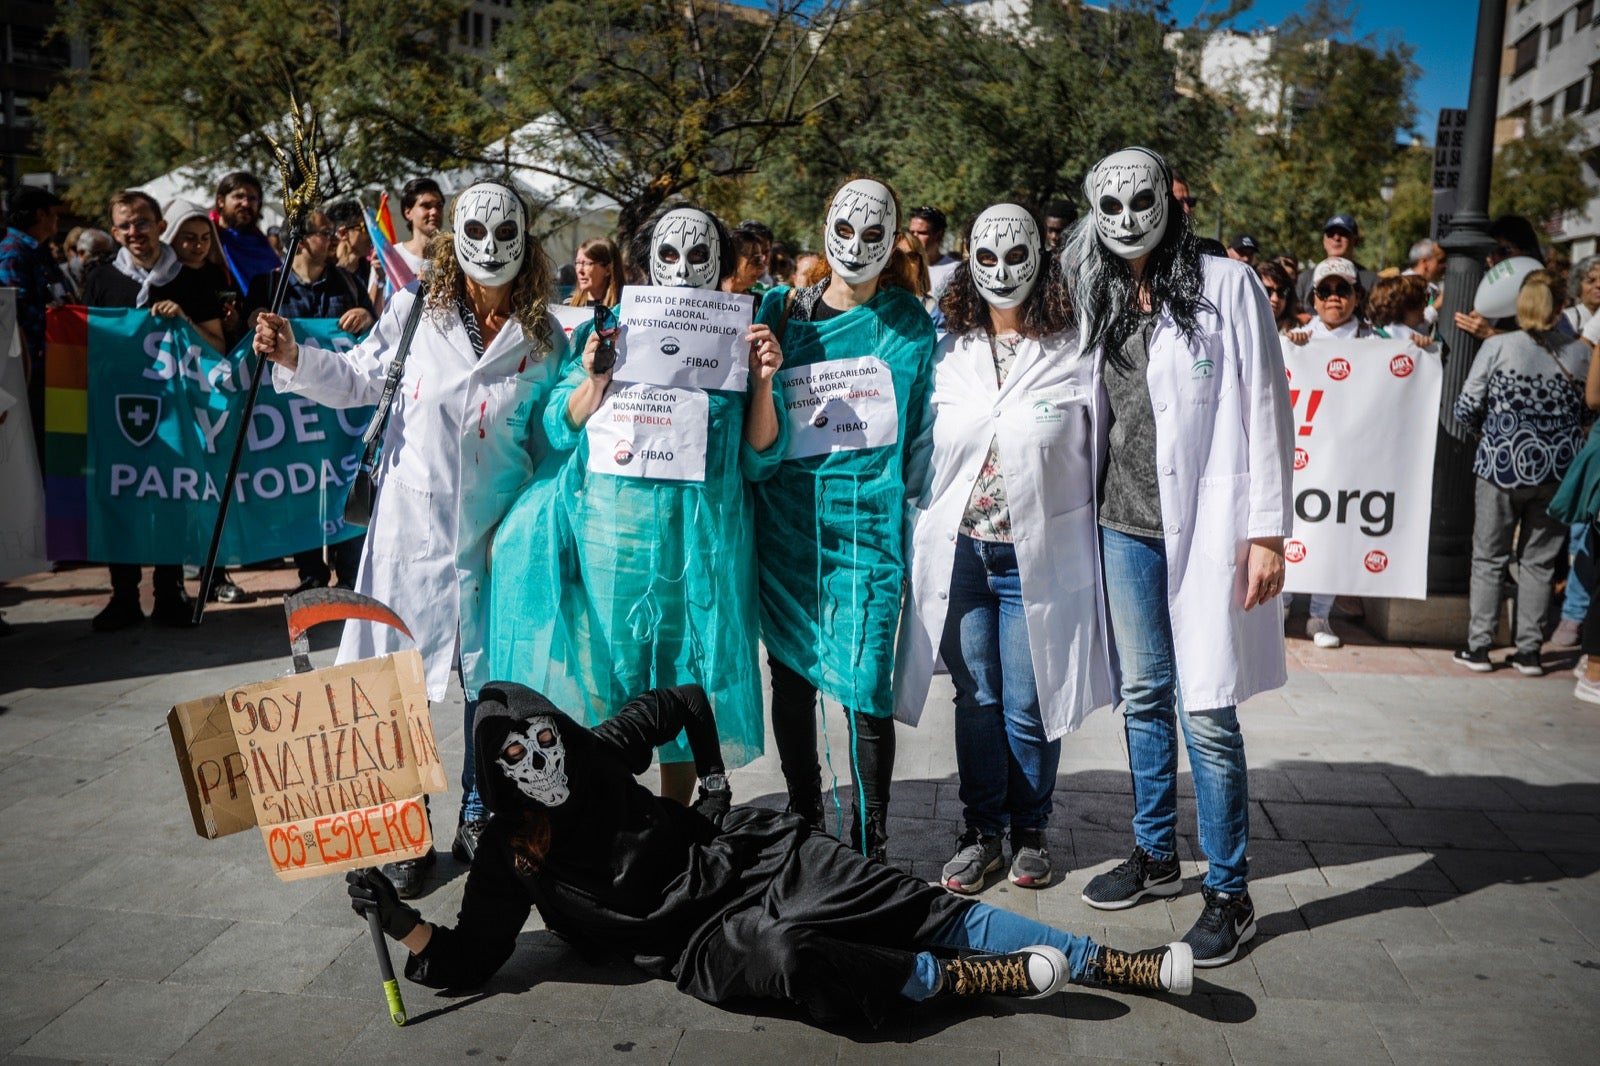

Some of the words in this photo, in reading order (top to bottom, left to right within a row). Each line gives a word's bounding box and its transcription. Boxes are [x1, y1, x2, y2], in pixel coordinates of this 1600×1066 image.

[634, 294, 663, 304] BASTA
[664, 297, 678, 305] DE
[679, 298, 741, 312] PRECARIEDAD
[626, 317, 699, 332] INVESTIGACIÓN
[699, 323, 738, 336] PÚBLICA
[805, 374, 818, 384] DE
[818, 366, 879, 383] PRECARIEDAD
[612, 402, 673, 414] BIOSANITARIA
[194, 407, 230, 454] Y
[247, 398, 326, 452] DE
[612, 413, 632, 424] 100%
[633, 414, 672, 427] PÚBLICA
[110, 463, 221, 501] PARA
[233, 453, 360, 504] TODAS
[231, 690, 302, 736] SOY
[325, 676, 379, 728] LA
[269, 824, 307, 871] OS
[314, 801, 426, 865] ESPERO
